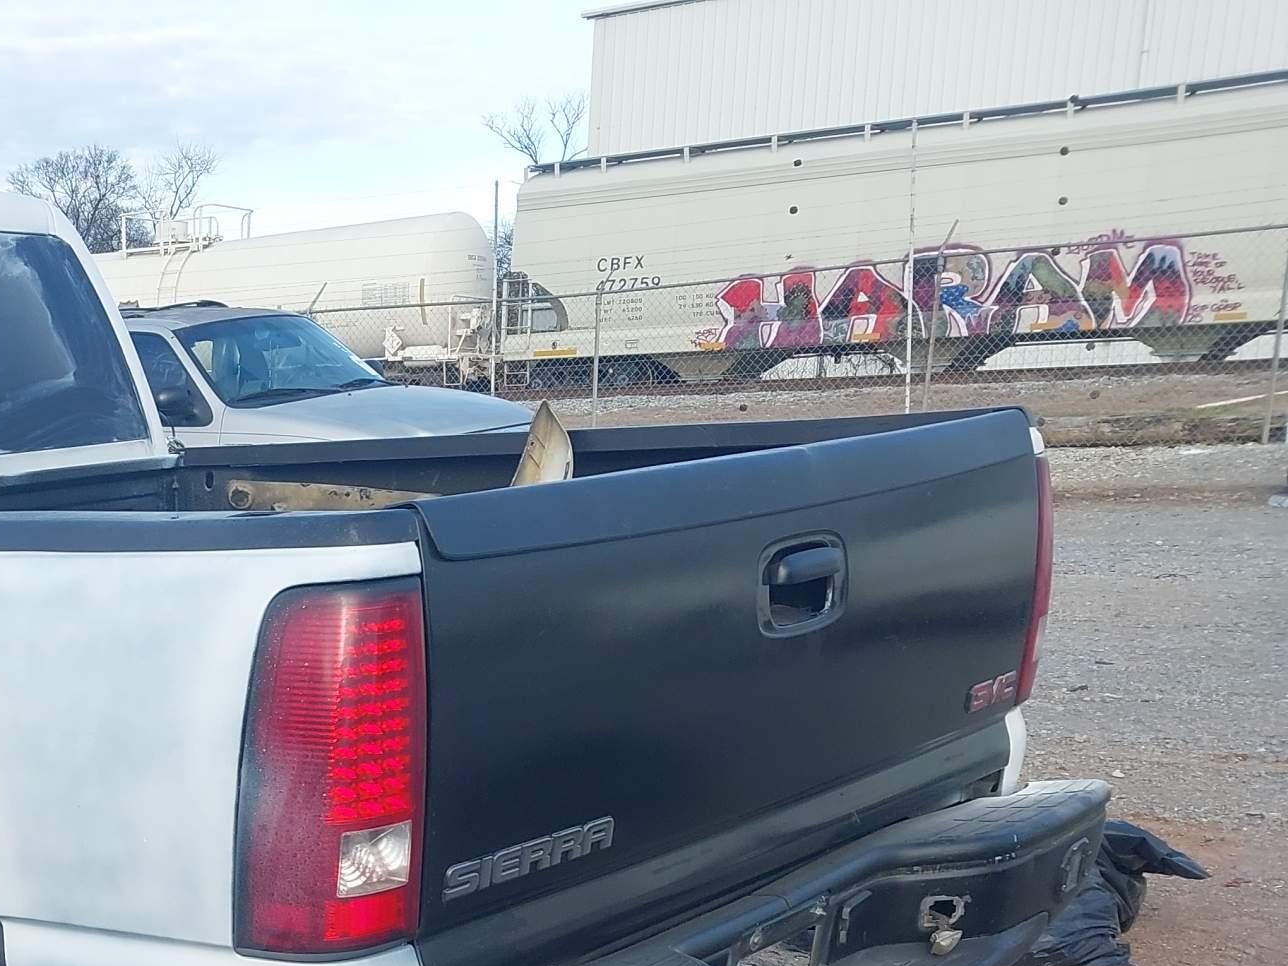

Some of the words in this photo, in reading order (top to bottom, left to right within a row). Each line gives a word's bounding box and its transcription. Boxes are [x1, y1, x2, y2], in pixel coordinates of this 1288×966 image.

[597, 255, 644, 272] CBFX
[596, 276, 661, 292] 472759
[968, 670, 1017, 713] GMC
[442, 815, 615, 903] SIERRA
